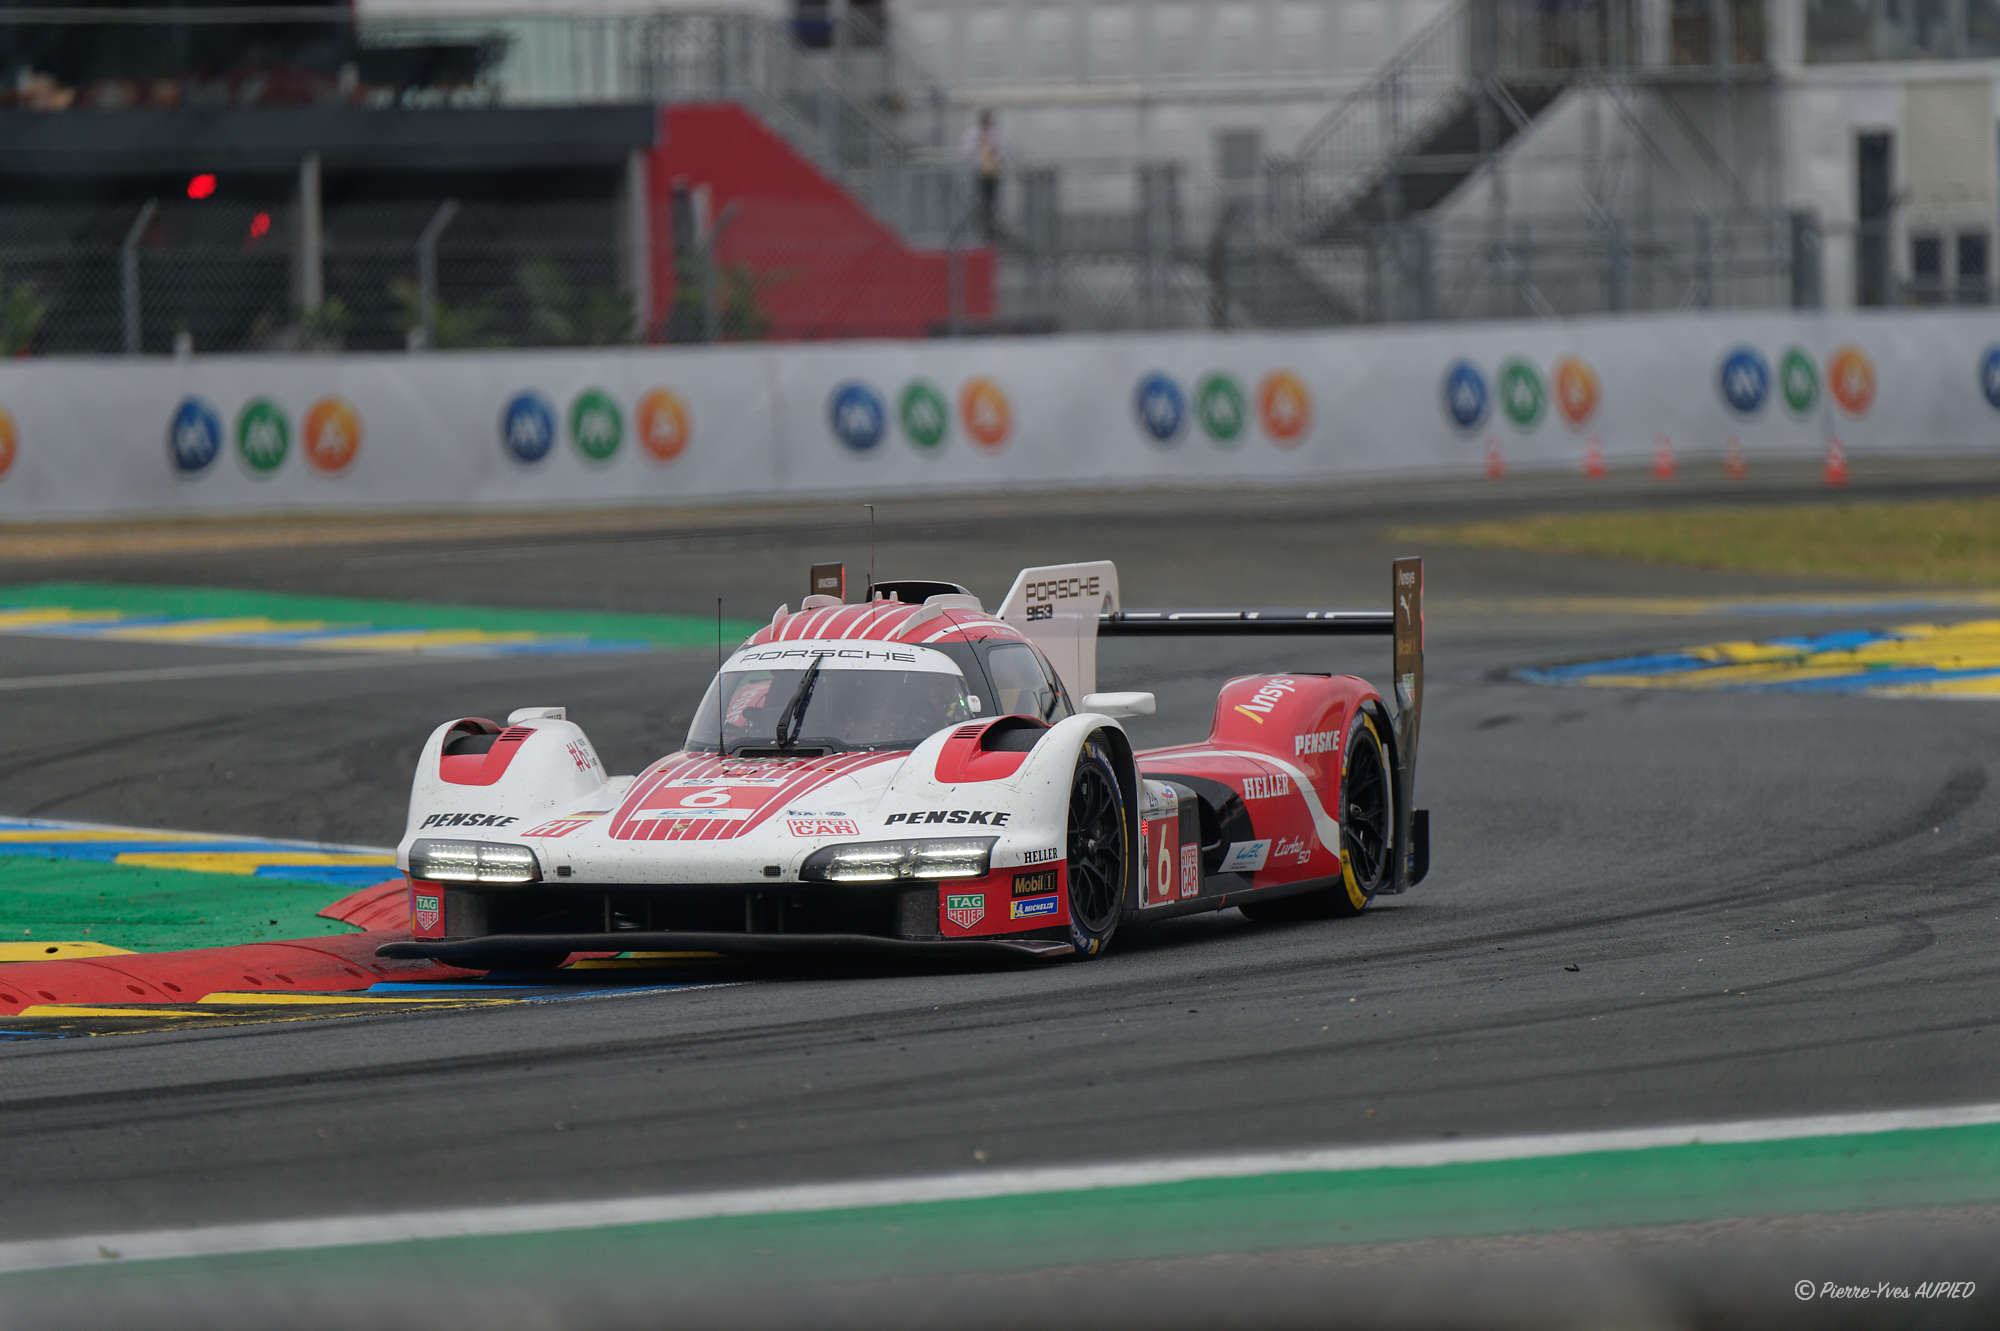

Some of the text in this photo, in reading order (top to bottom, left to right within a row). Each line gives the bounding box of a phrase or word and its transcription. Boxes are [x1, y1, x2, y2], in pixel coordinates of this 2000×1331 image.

[1026, 577, 1099, 602] PORSCHE
[1026, 604, 1053, 621] 963
[739, 650, 916, 663] PORSCHE
[1295, 730, 1340, 756] PENSKE
[1243, 773, 1289, 800] HELLER
[680, 787, 732, 807] 6
[419, 813, 519, 830] PENSKE
[884, 810, 1011, 827] PENSKE
[795, 825, 854, 835] CAR
[1024, 847, 1058, 863] HELLER
[1158, 823, 1171, 896] 6
[1015, 874, 1044, 894] Mobil
[1182, 865, 1198, 893] CAR
[419, 899, 437, 909] TAG
[950, 896, 982, 907] TAG
[1024, 902, 1054, 912] MICHELIN
[950, 909, 983, 926] HEUER
